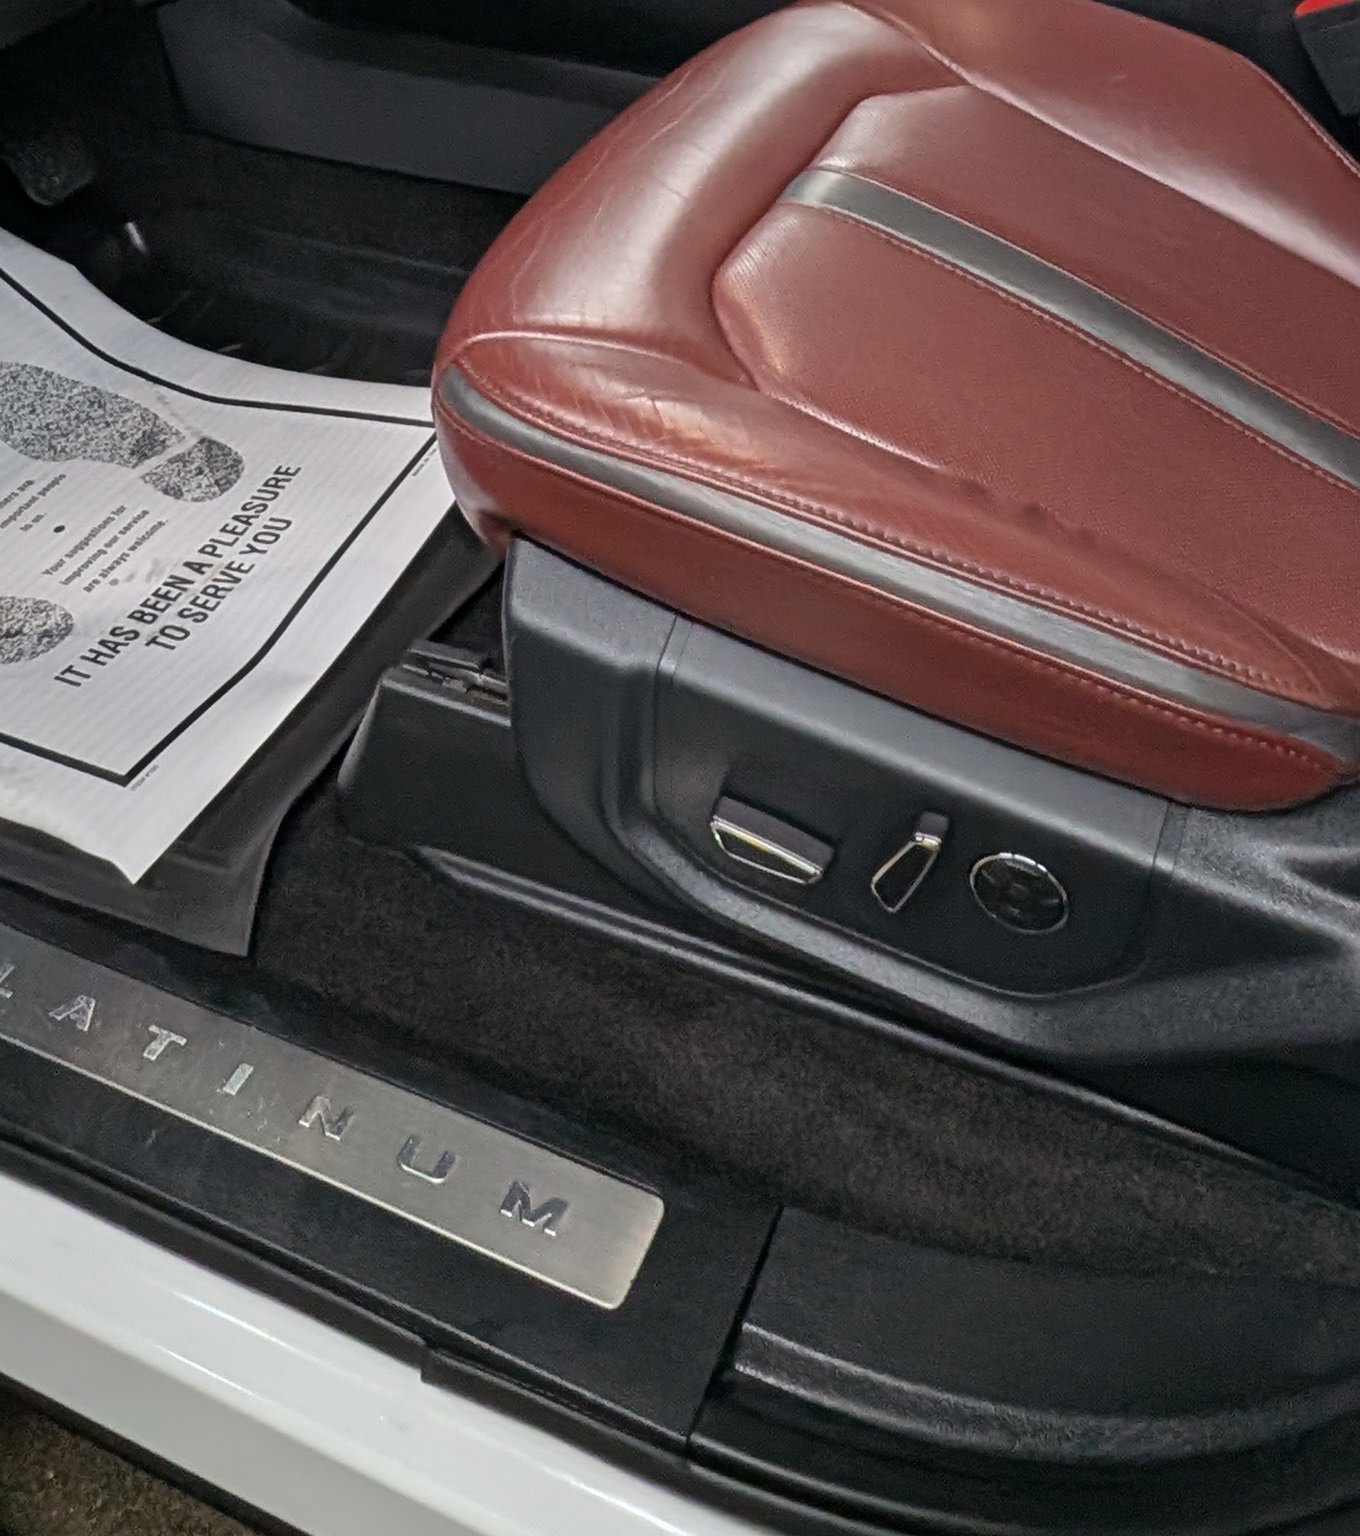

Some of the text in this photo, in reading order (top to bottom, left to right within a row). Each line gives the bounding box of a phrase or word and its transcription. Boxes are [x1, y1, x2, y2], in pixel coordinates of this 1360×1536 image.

[37, 474, 67, 497] people
[41, 505, 127, 575] Your suggestions for
[53, 465, 302, 687] IT HAS BEEN A PLEASURE
[59, 510, 150, 585] improving our service
[83, 578, 101, 593] are
[98, 552, 130, 579] always
[145, 516, 293, 651] TO SERVE YOU
